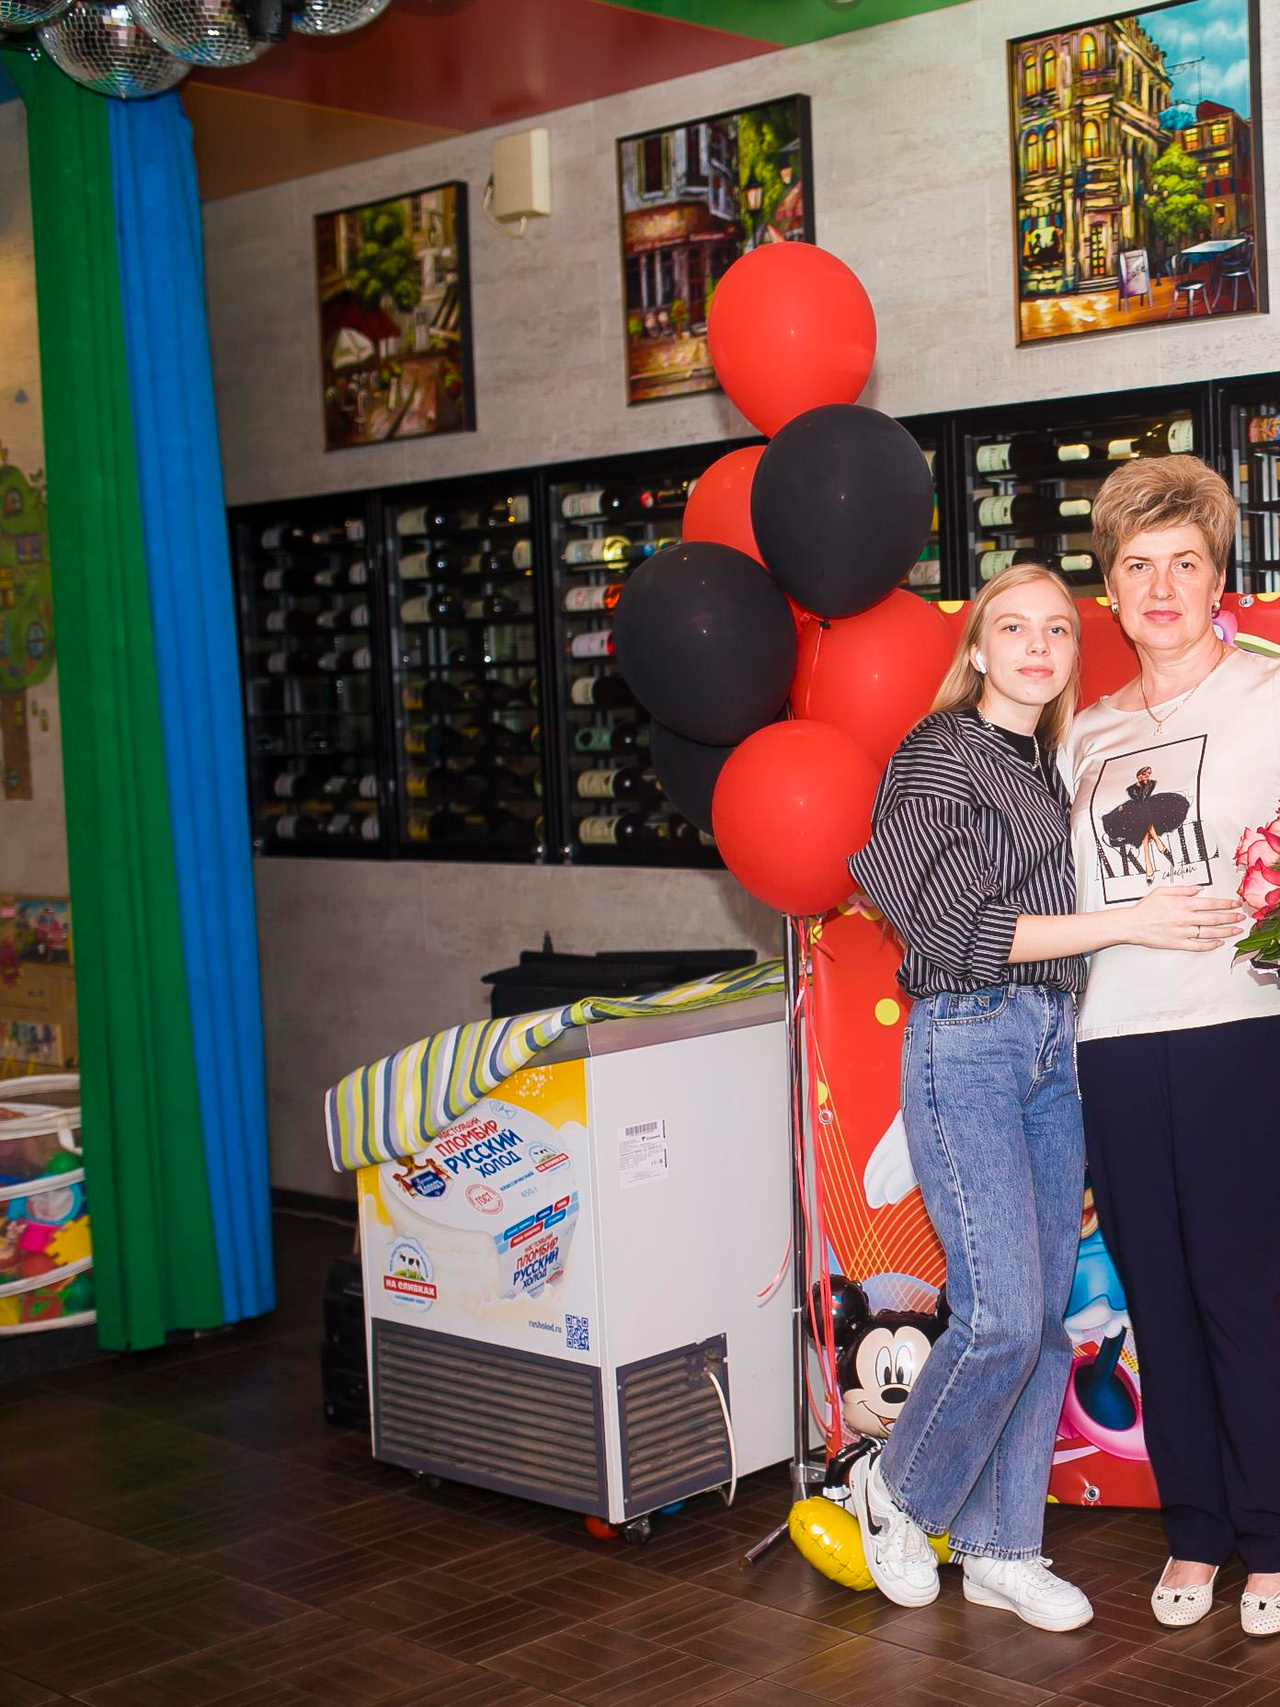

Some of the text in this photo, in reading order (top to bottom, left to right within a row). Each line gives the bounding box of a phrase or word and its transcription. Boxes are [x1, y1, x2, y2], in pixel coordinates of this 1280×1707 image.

[434, 1120, 499, 1158] ПЛОМБИР
[443, 1128, 524, 1175] РУССКИЙ
[475, 1150, 522, 1178] ХОЛОД
[513, 1246, 560, 1286] РУССКИЙ
[516, 1236, 559, 1270] ПЛОМБИР
[385, 1279, 435, 1297] НА СЛИВКАХ
[528, 1321, 562, 1334] rusholod.ru
